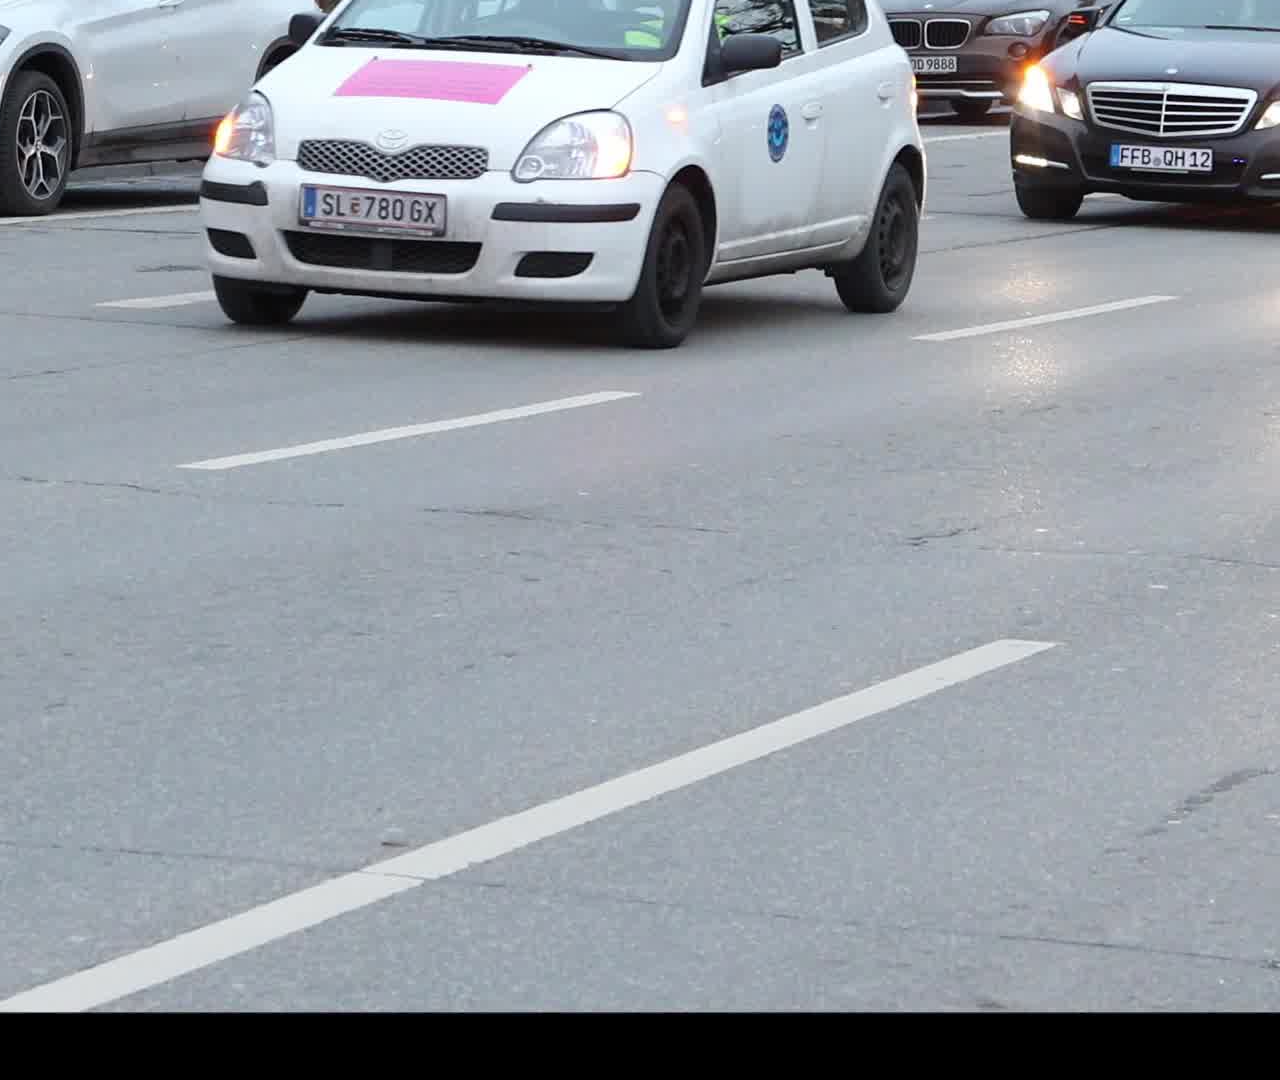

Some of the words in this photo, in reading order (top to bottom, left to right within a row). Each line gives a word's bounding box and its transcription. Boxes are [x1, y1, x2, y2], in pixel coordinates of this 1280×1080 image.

[926, 58, 955, 70] 9888
[1120, 147, 1152, 165] FFB
[1163, 149, 1186, 167] QH
[1189, 151, 1211, 168] 12
[321, 192, 346, 217] SL
[364, 196, 405, 221] 780
[410, 199, 438, 224] GX
